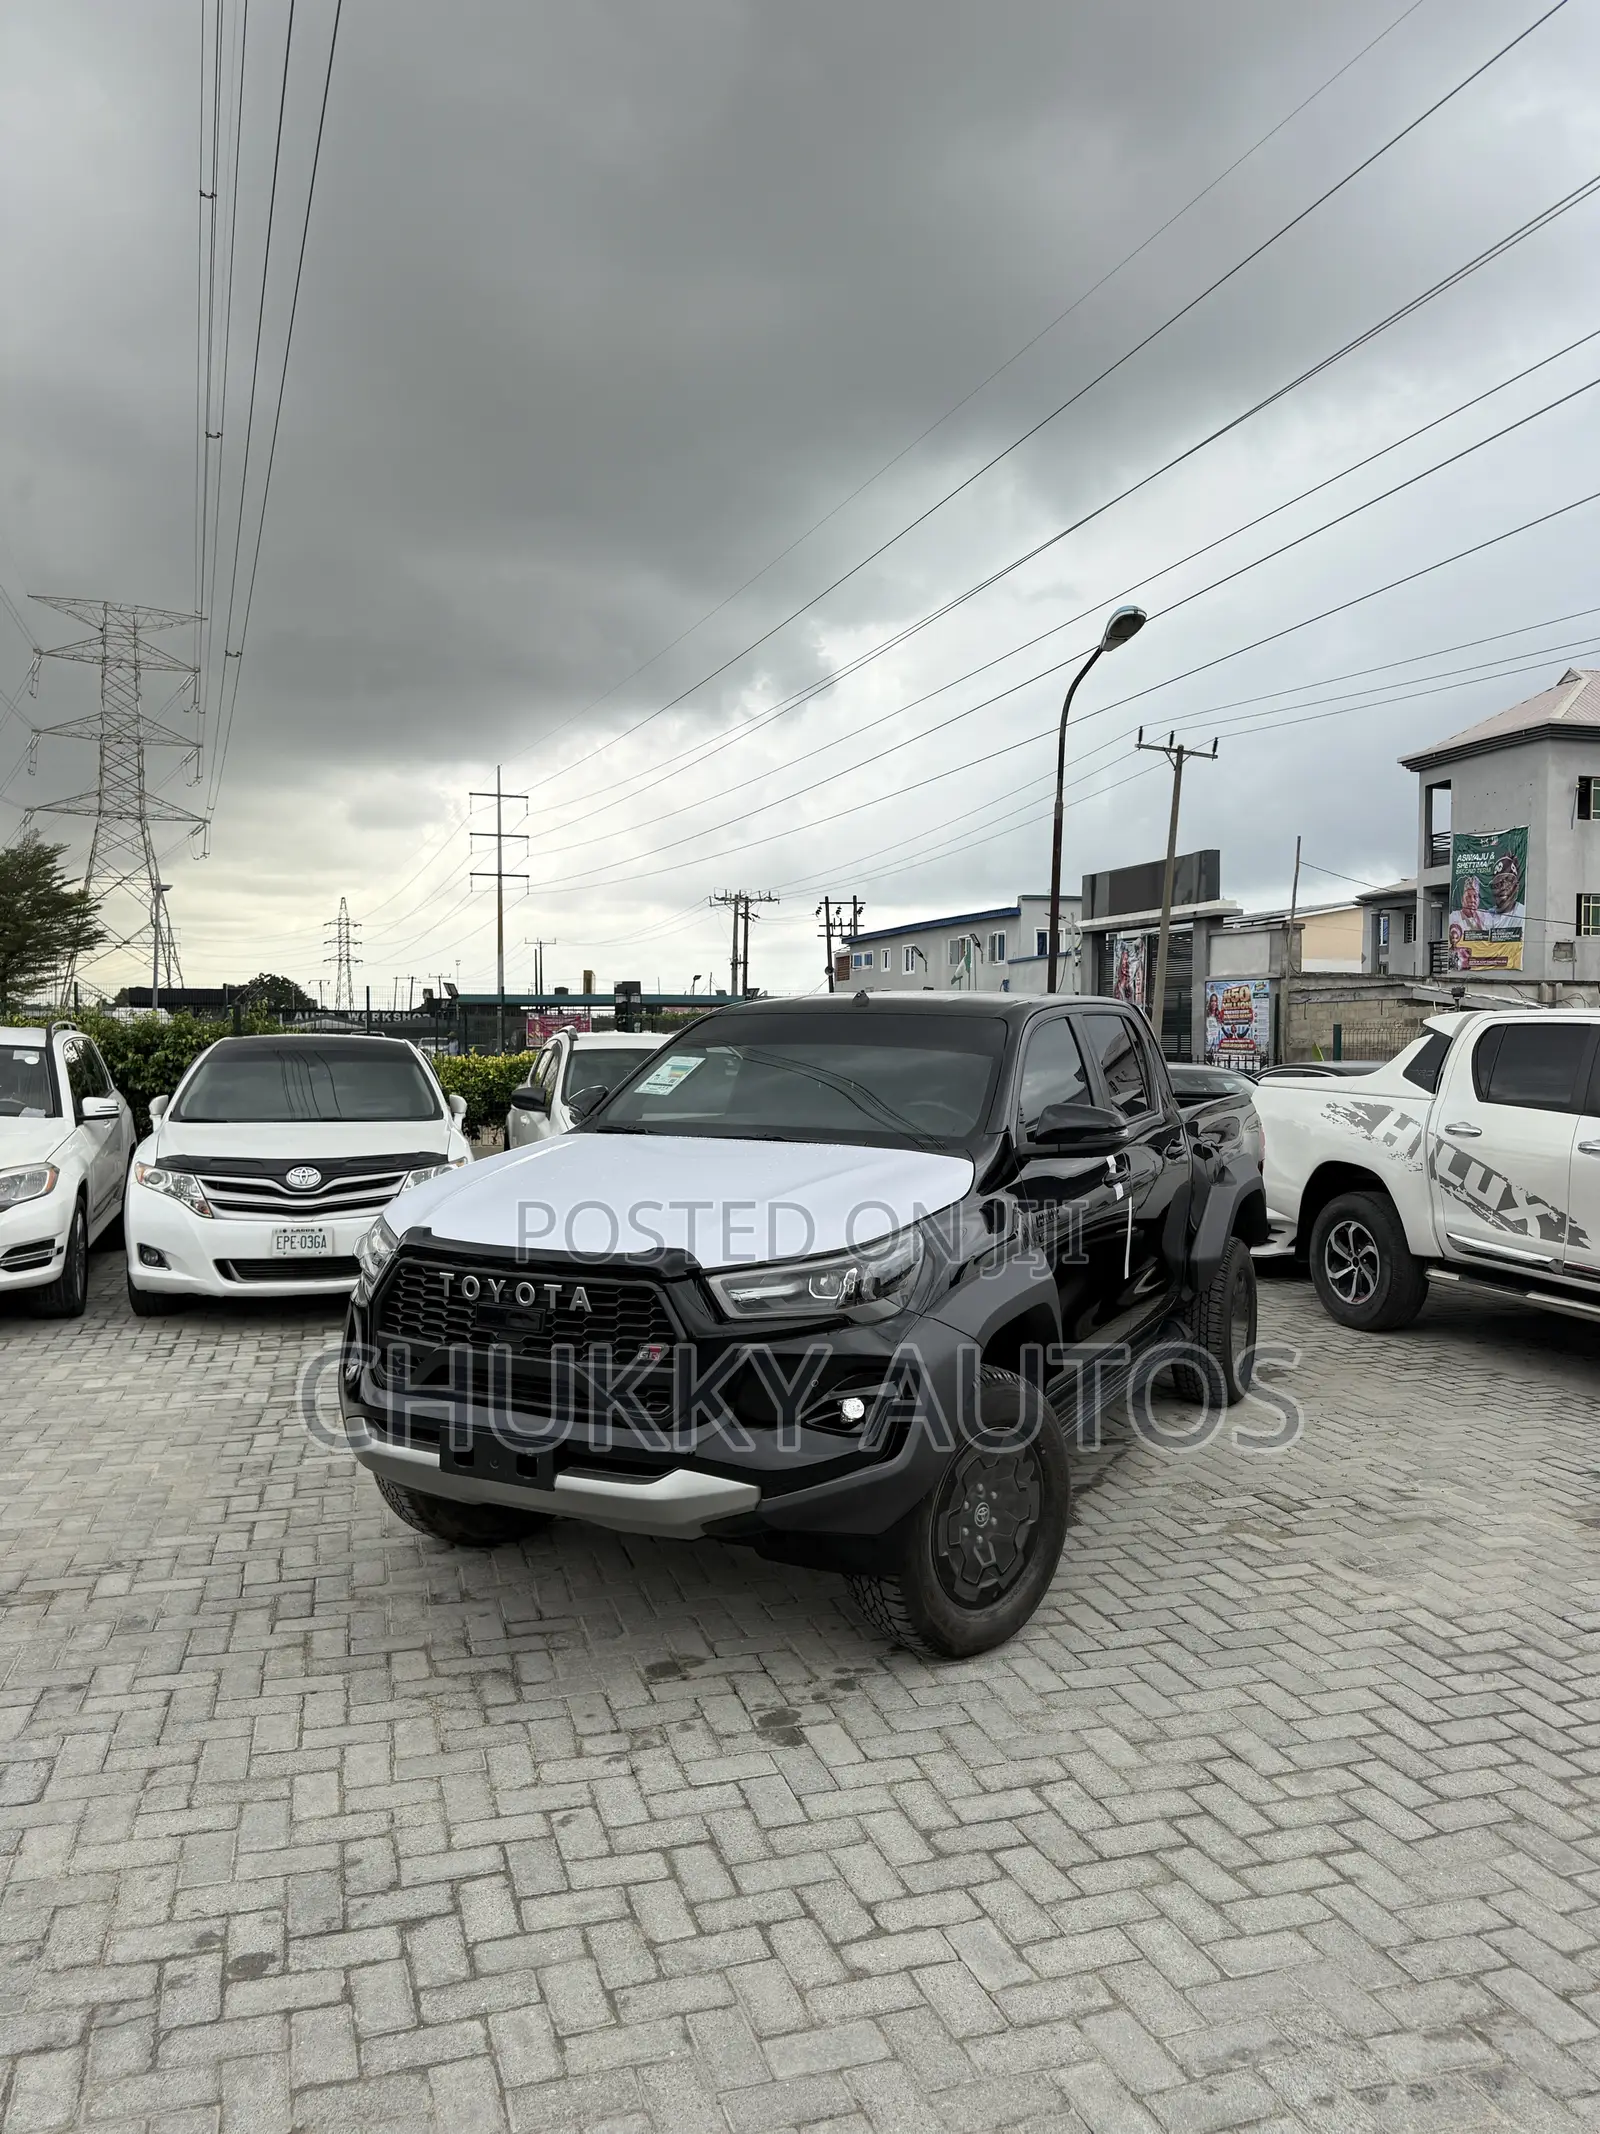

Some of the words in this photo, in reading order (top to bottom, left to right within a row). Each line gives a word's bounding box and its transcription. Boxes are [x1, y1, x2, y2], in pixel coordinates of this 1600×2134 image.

[1456, 852, 1489, 861] ASIWAJU
[1489, 851, 1495, 860] &
[1456, 861, 1488, 869] SHETTIMA
[1223, 1001, 1252, 1010] MILLION
[1372, 1104, 1547, 1240] HILUX
[276, 1234, 327, 1250] EPE-03GA
[439, 1271, 593, 1313] TOYOTA
